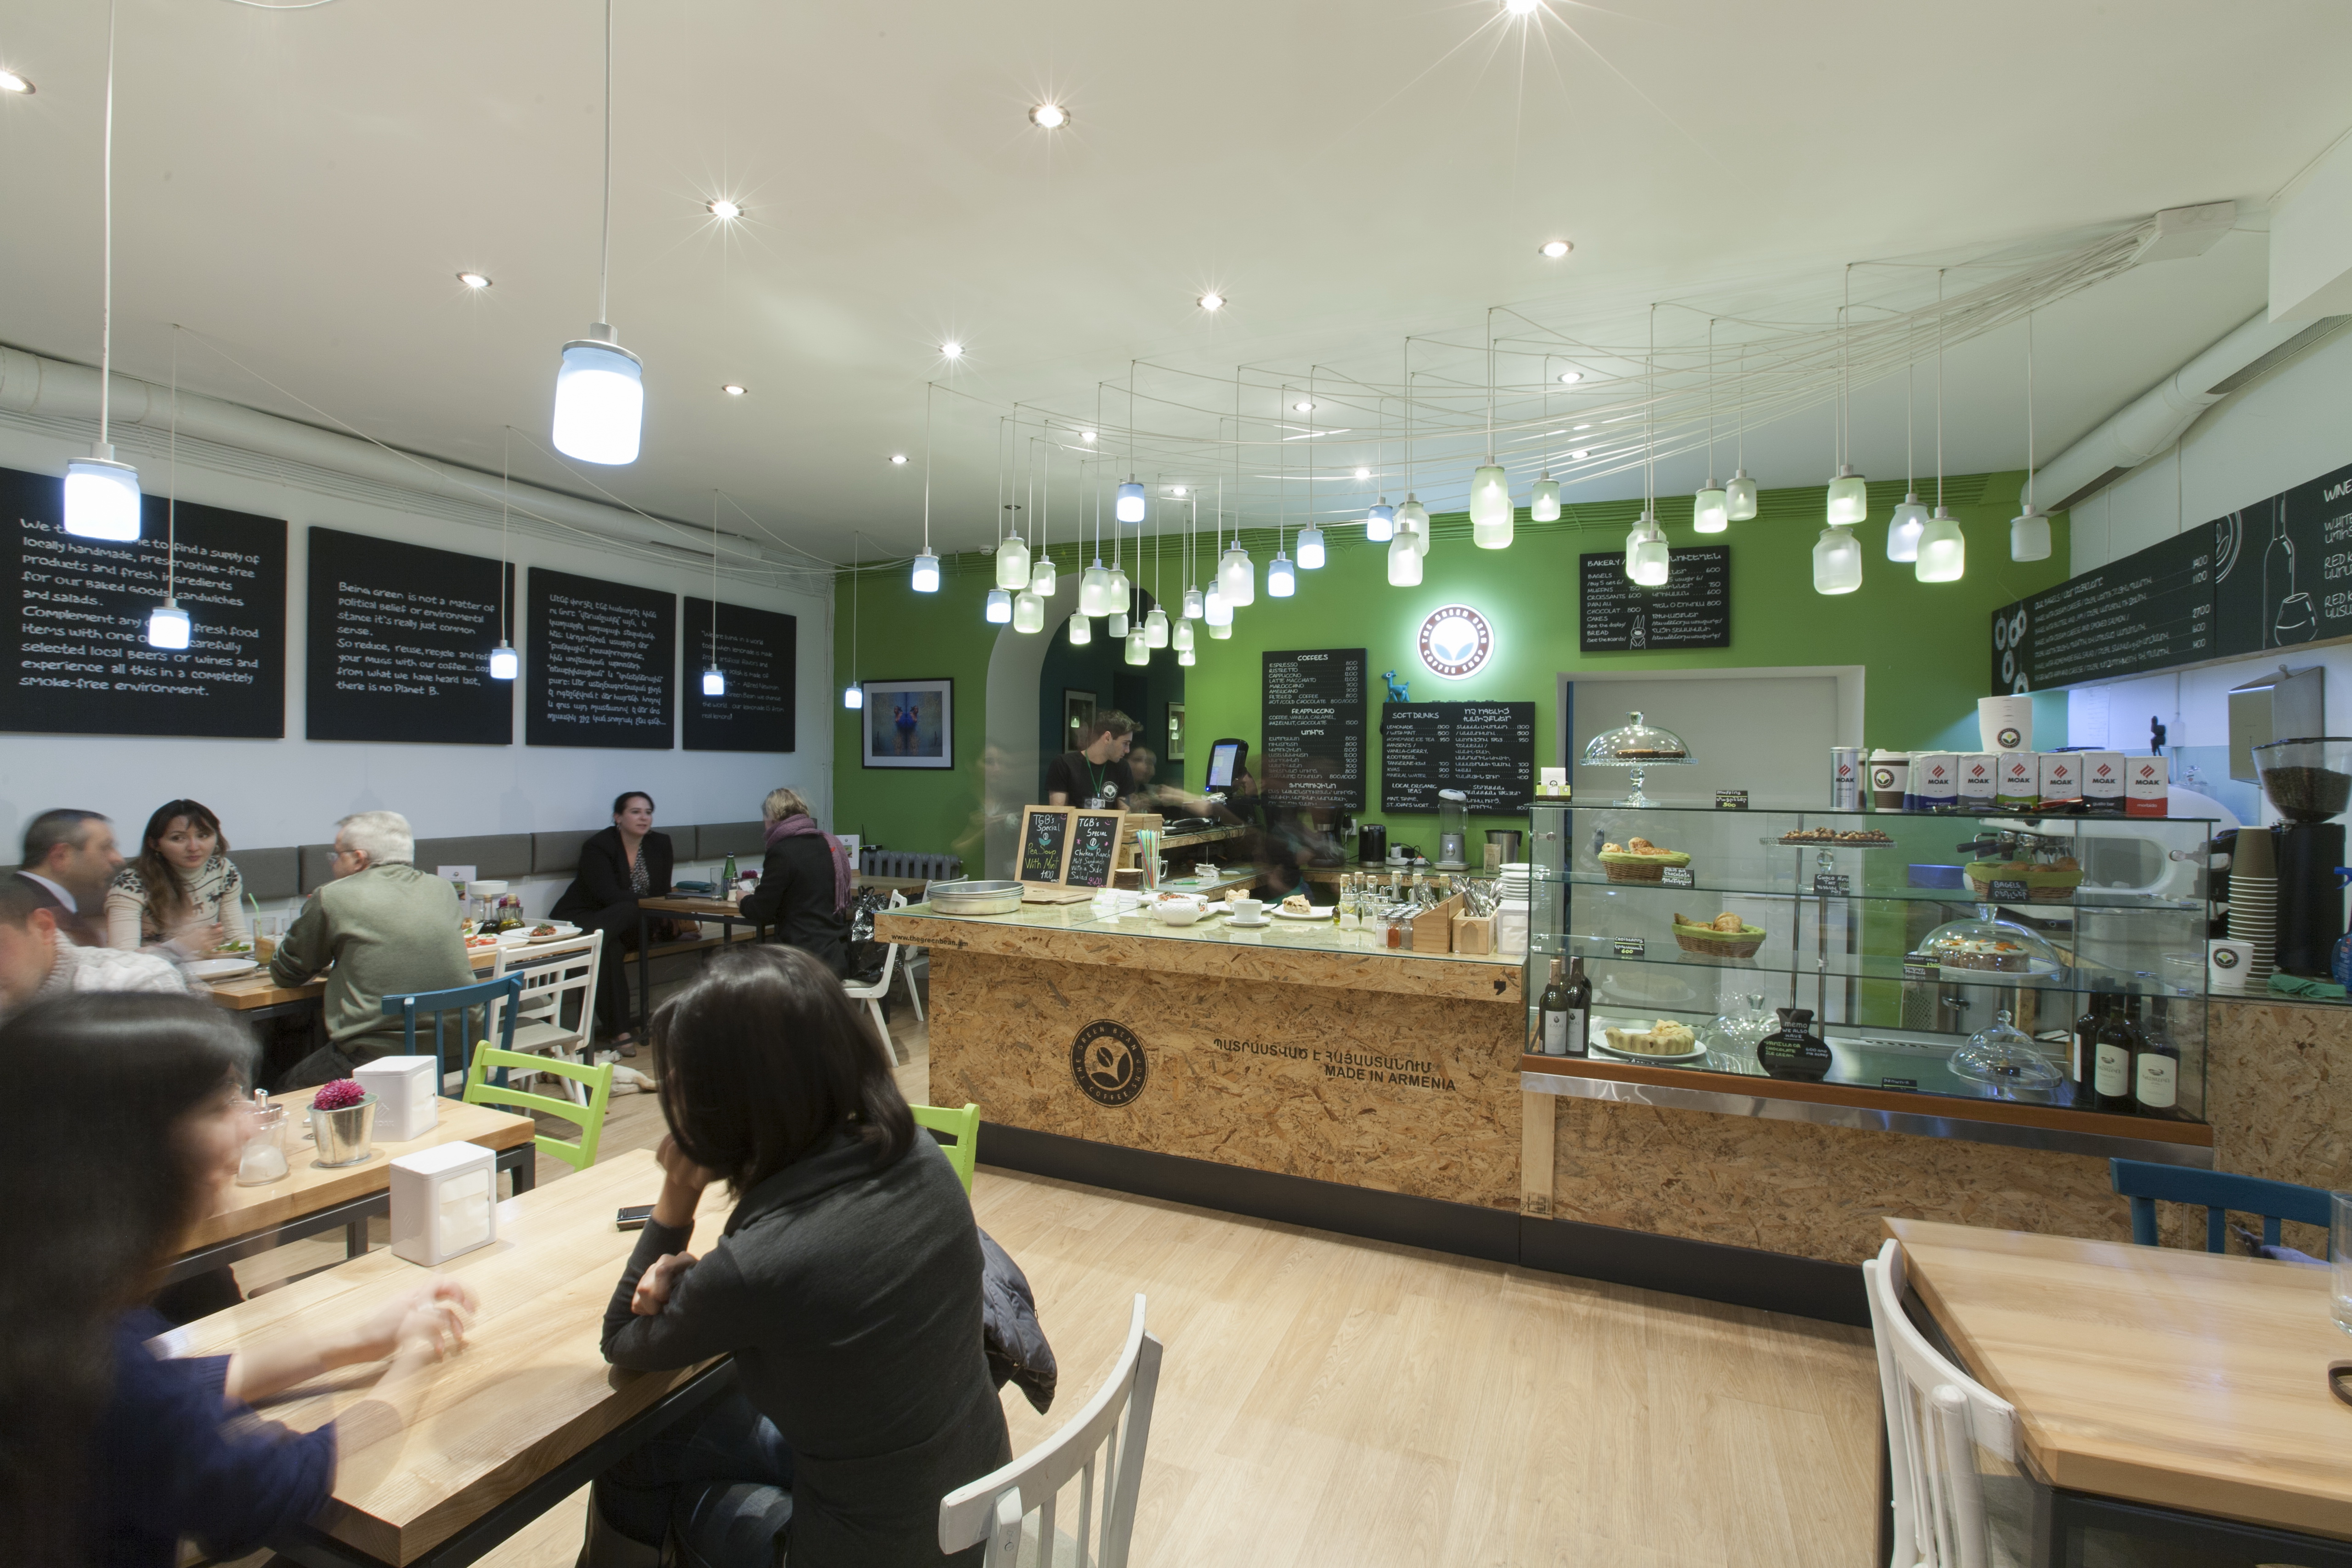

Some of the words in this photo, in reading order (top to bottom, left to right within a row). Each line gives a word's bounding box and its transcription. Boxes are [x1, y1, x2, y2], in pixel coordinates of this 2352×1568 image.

[20, 519, 51, 532] We
[173, 542, 198, 554] find
[210, 550, 243, 562] supply
[23, 537, 66, 553] locally
[68, 543, 137, 562] handmade,
[2324, 552, 2346, 570] RED
[23, 555, 88, 571] products
[92, 564, 116, 575] and
[120, 568, 158, 580] fresh
[162, 572, 233, 590] ingredients
[21, 571, 51, 582] for
[175, 592, 244, 606] sandwiches
[23, 590, 49, 600] and
[52, 594, 103, 606] salads.
[418, 596, 437, 604] not
[339, 598, 377, 609] political
[424, 610, 484, 623] environmental
[22, 606, 115, 624] Complement
[193, 623, 227, 636] fresh
[229, 627, 259, 638] food
[337, 611, 372, 622] stance
[394, 619, 417, 629] really
[419, 621, 436, 630] just
[440, 625, 475, 634] common
[22, 623, 66, 636] items
[106, 632, 135, 641] one
[189, 639, 241, 654] carefully
[337, 627, 373, 636] sense.
[21, 642, 86, 655] selected
[90, 646, 122, 657] local
[195, 655, 233, 666] wines
[237, 659, 258, 668] and
[354, 641, 390, 652] reduce,
[395, 645, 424, 656] reuse,
[425, 649, 455, 658] recycle
[338, 655, 362, 663] your
[21, 661, 104, 673] experience
[130, 665, 157, 676] this
[191, 671, 253, 684] completely
[336, 667, 363, 676] from
[367, 669, 391, 678] what
[413, 673, 433, 682] have
[435, 674, 459, 684] heard
[19, 677, 109, 690] smoke-free
[114, 682, 209, 696] environment.
[336, 681, 365, 690] there
[394, 684, 424, 694] Planet
[1033, 814, 1055, 826] TGB's
[1036, 823, 1060, 834] Special
[1079, 818, 1099, 827] TGB's
[1027, 843, 1038, 855] Pea
[1040, 844, 1057, 859] Soup
[1096, 848, 1111, 859] Ranch
[1025, 858, 1041, 869] With
[1043, 856, 1060, 870] Mint
[1083, 857, 1105, 865] Sandwich
[1089, 864, 1102, 873] Side
[1069, 872, 1088, 881] Salad
[1087, 877, 1102, 885] 2400
[891, 934, 968, 946] www.thegreenbean.am
[1078, 1026, 1105, 1050] GREEN
[1113, 1028, 1137, 1051] BEAN
[1213, 1038, 1308, 1059] ՊԱՏՐԱՍՏՎԱԾ
[1325, 1051, 1432, 1073] ՀԱՅԱՍՏԱՆՈՒՄ
[1076, 1058, 1085, 1081] THE
[1324, 1065, 1366, 1081] MADE
[1369, 1070, 1384, 1082] IN
[1387, 1072, 1457, 1091] ARMENIA
[1089, 1086, 1128, 1100] COFFEE
[1131, 1059, 1142, 1088] SHOP
